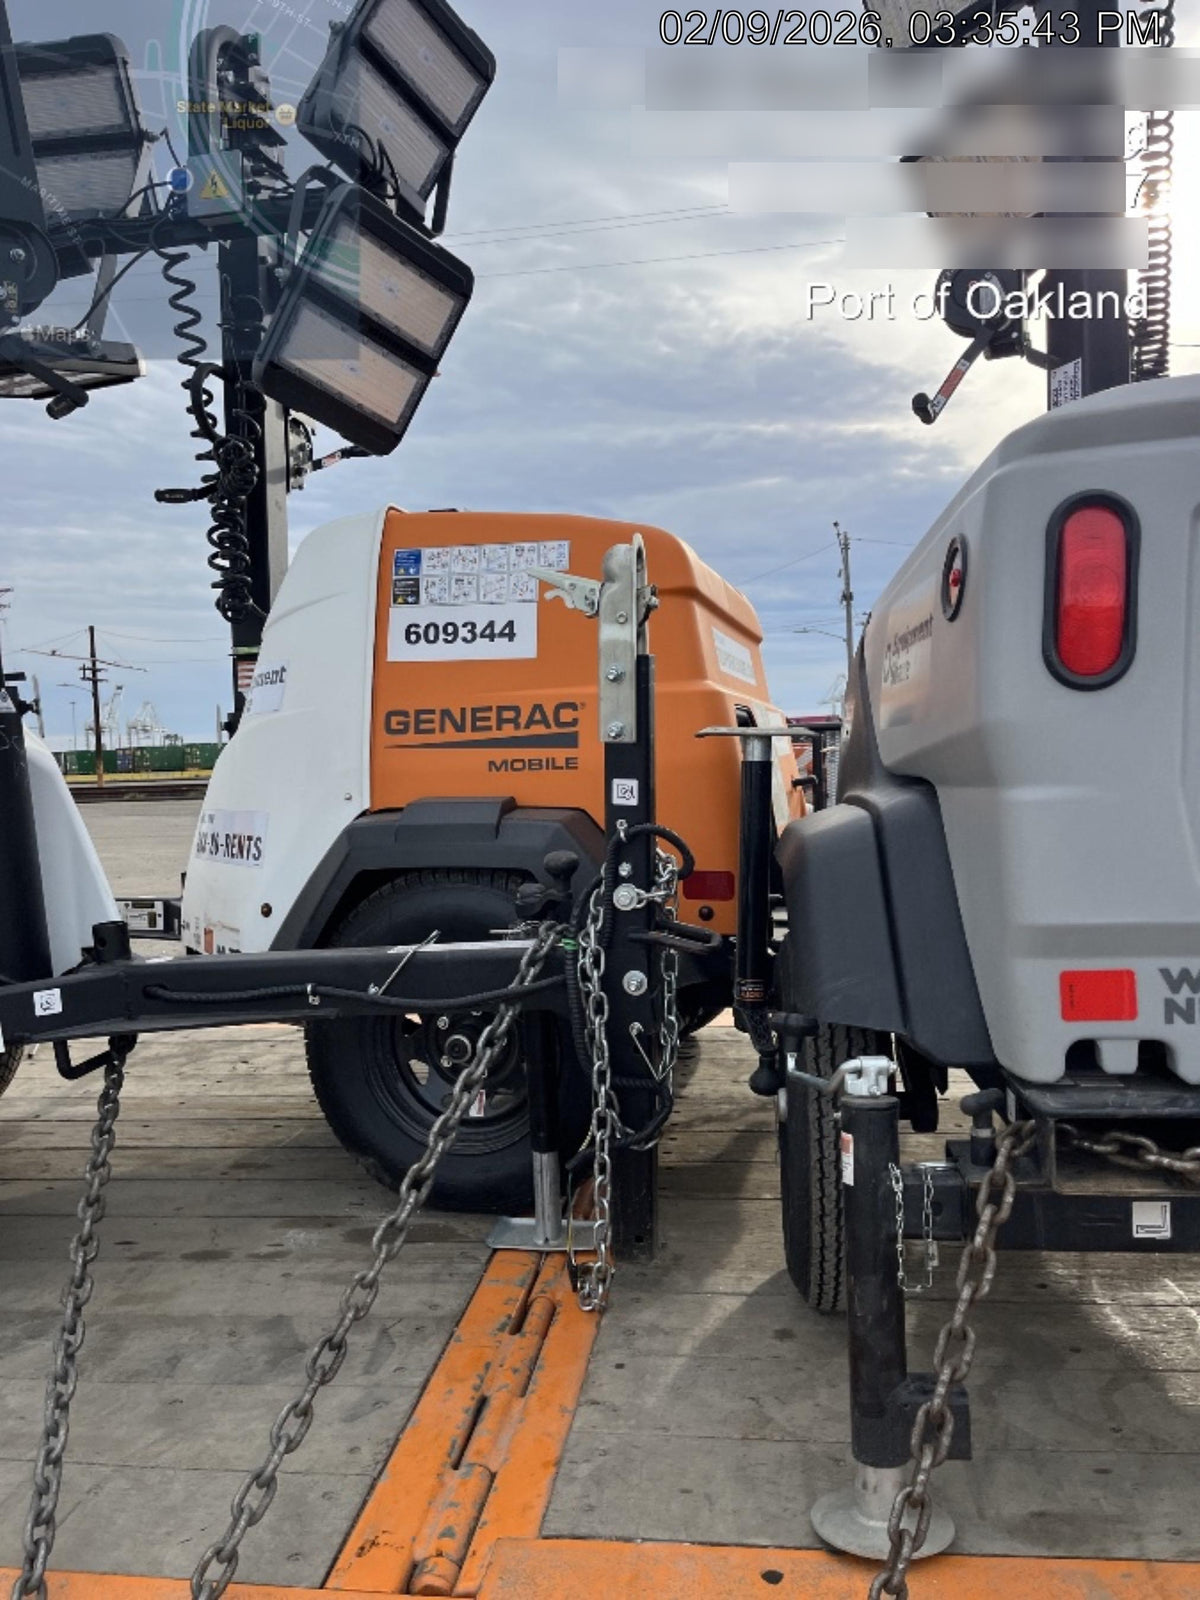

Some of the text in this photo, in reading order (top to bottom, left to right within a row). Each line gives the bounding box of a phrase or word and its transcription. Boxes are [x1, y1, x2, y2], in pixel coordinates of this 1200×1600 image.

[404, 619, 517, 645] 609344
[384, 701, 580, 735] GENERAC
[488, 756, 579, 772] MOBILE
